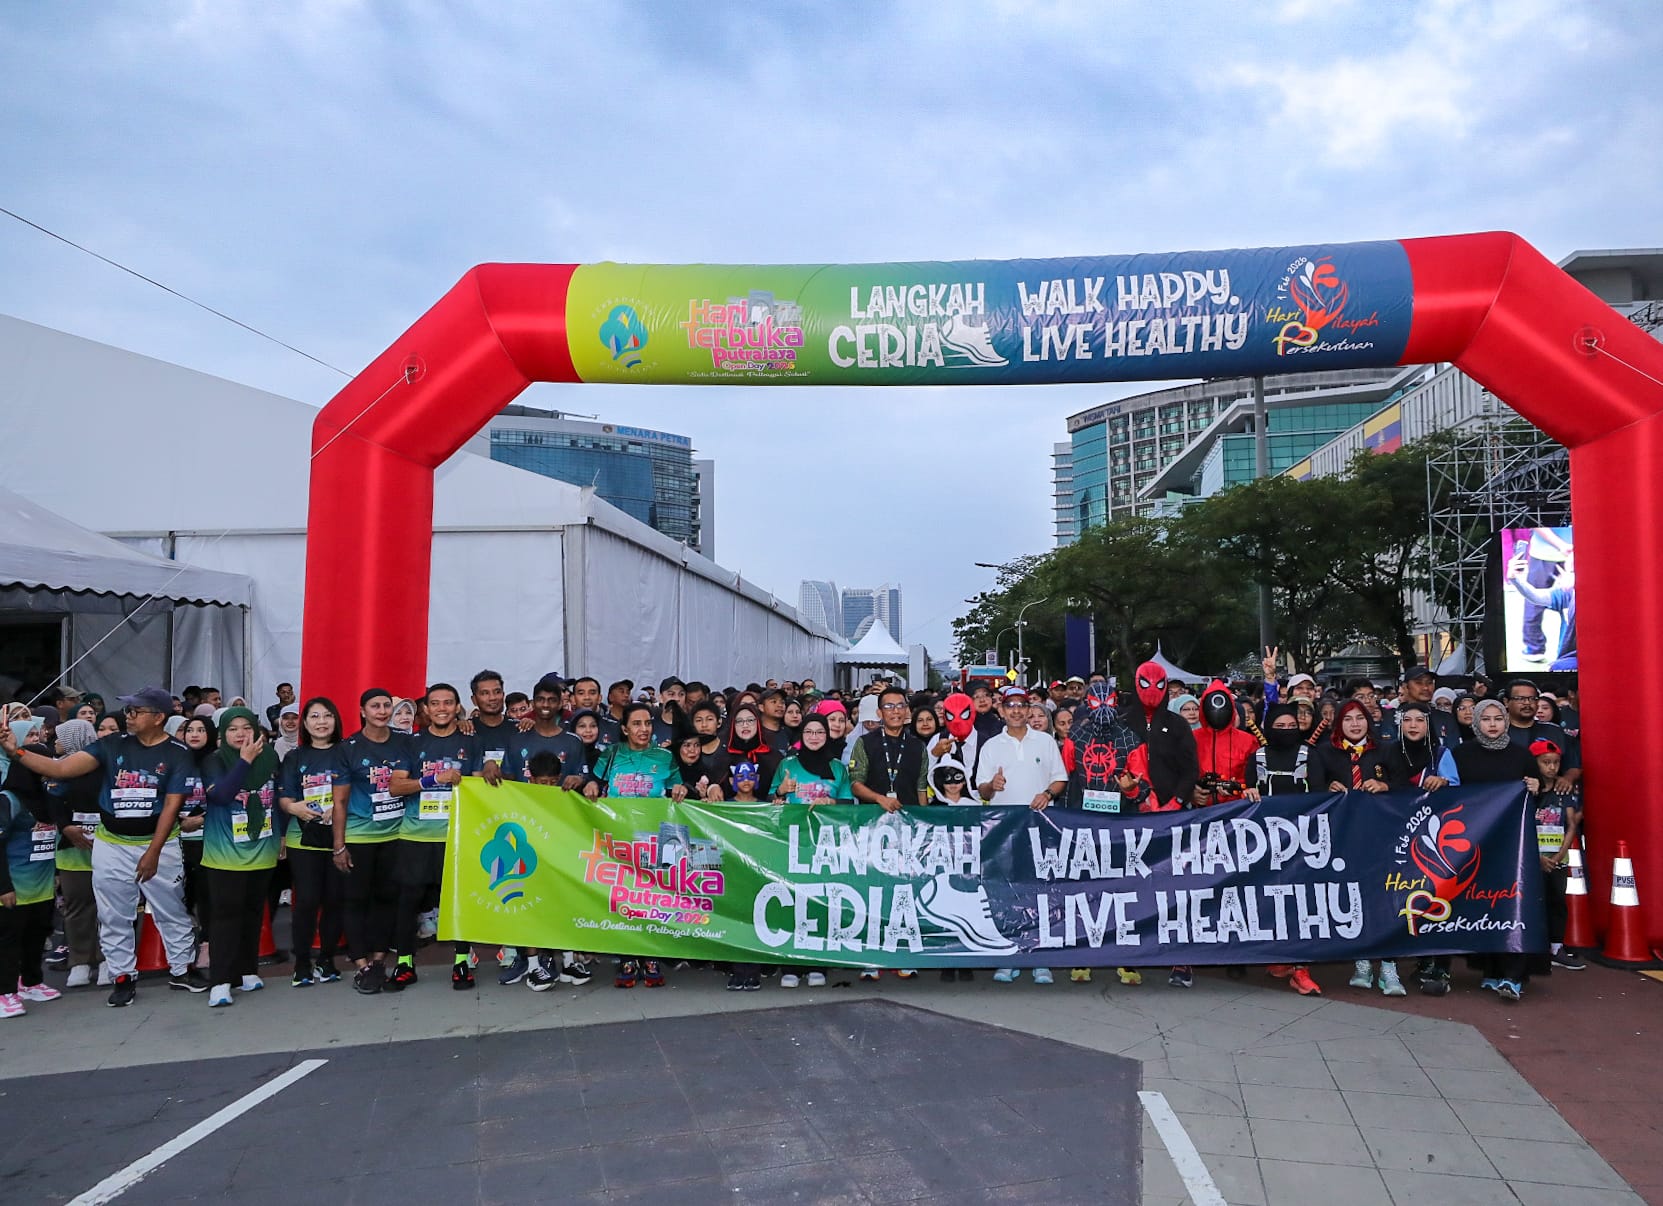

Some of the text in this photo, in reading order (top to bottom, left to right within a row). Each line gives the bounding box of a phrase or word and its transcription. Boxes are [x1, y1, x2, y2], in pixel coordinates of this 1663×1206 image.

[1287, 256, 1308, 275] 2026
[689, 298, 748, 325] Hari
[850, 282, 985, 320] LANGKAH
[1016, 269, 1240, 317] WALK HAPPY.
[680, 315, 805, 349] Terbuka
[1265, 306, 1303, 324] Hari
[828, 322, 944, 369] CERIA
[1022, 312, 1248, 363] LIVE HEALTHY
[747, 360, 766, 371] Day
[616, 424, 689, 446] MENARA PETRA
[593, 827, 658, 866] Hari
[788, 824, 982, 876] LANGKAH
[1028, 813, 1346, 881] WALK HAPPY.
[1395, 834, 1410, 857] Feb
[1406, 805, 1432, 834] 2026
[578, 849, 725, 896] Terbuka
[1384, 871, 1427, 892] Hari
[619, 904, 711, 926] Open Day 2026
[753, 881, 924, 953] CERIA
[1036, 881, 1364, 948] LIVE HEALTHY
[1398, 889, 1526, 937] Persekutuan
